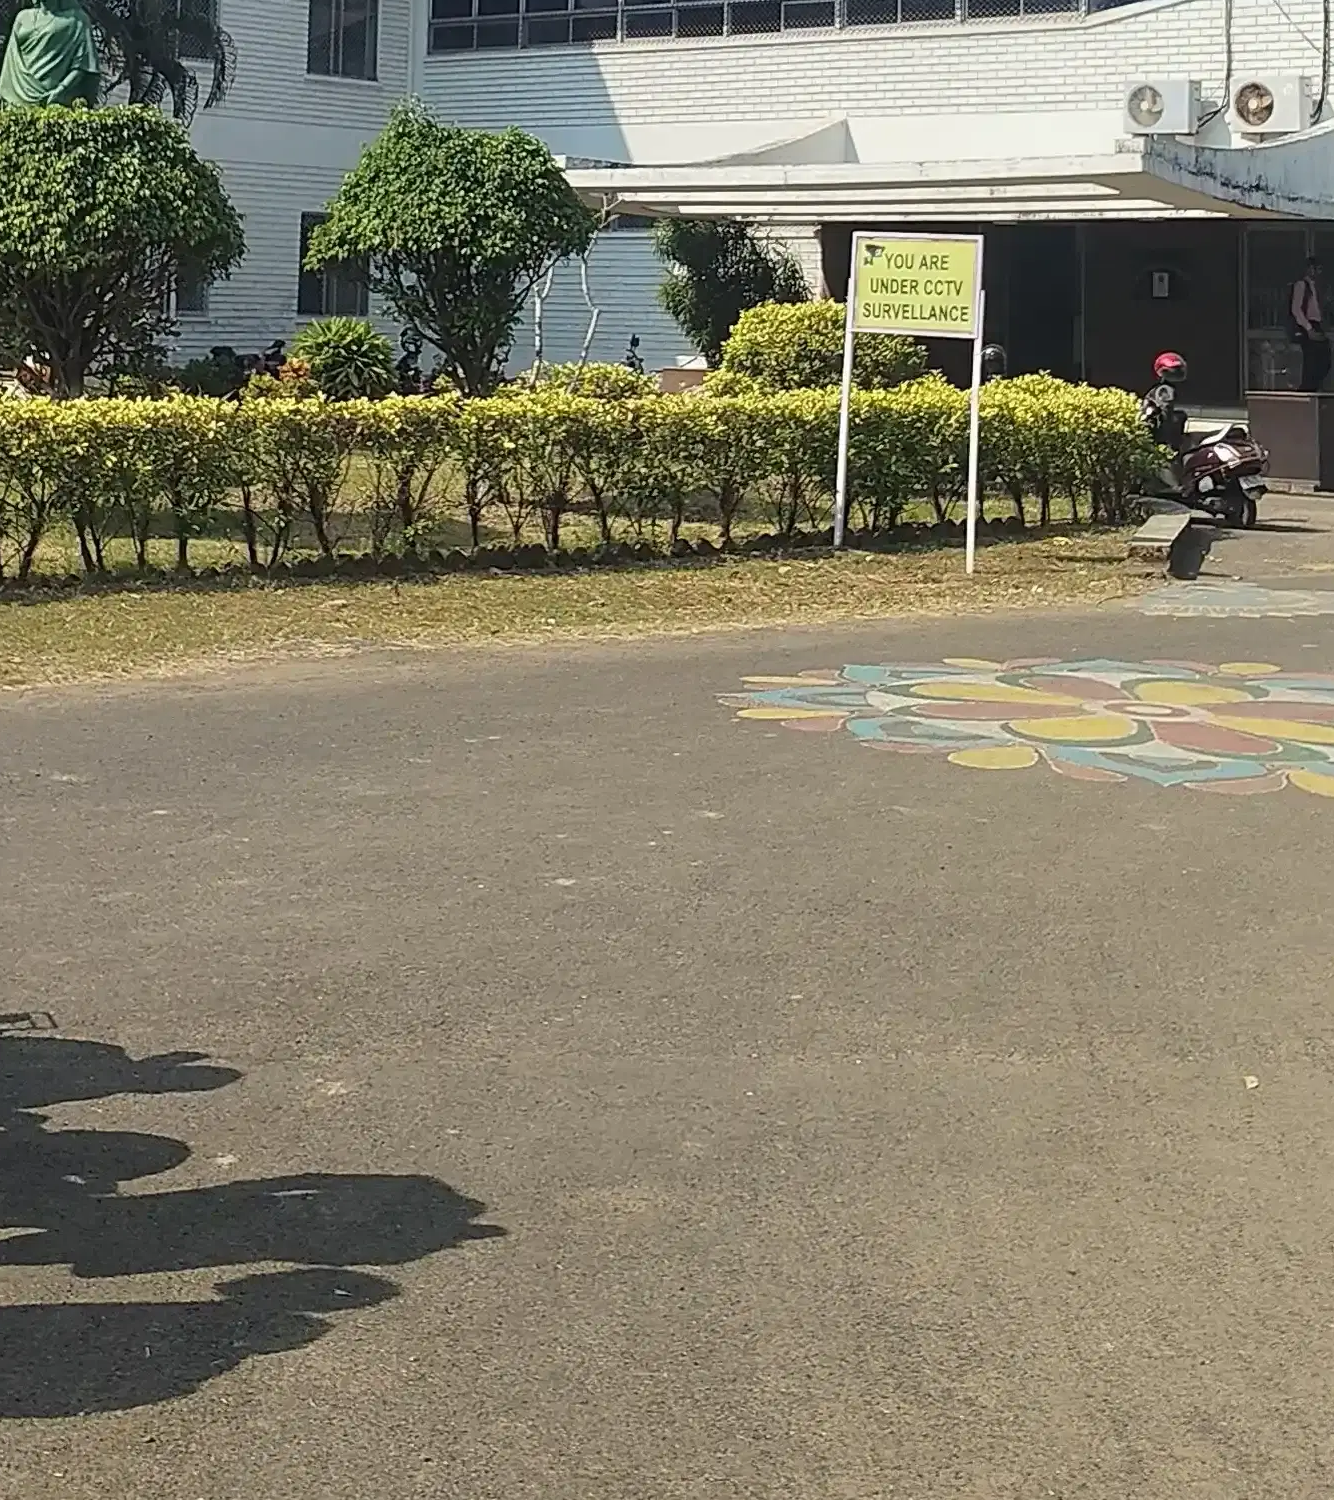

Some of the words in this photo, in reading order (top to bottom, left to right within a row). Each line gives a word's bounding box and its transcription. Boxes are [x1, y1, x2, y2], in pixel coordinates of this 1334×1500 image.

[884, 253, 914, 269] YOU
[919, 255, 950, 271] ARE
[870, 278, 919, 295] UNDER
[924, 280, 963, 296] CCTV
[862, 303, 969, 322] SURVELLANCE
